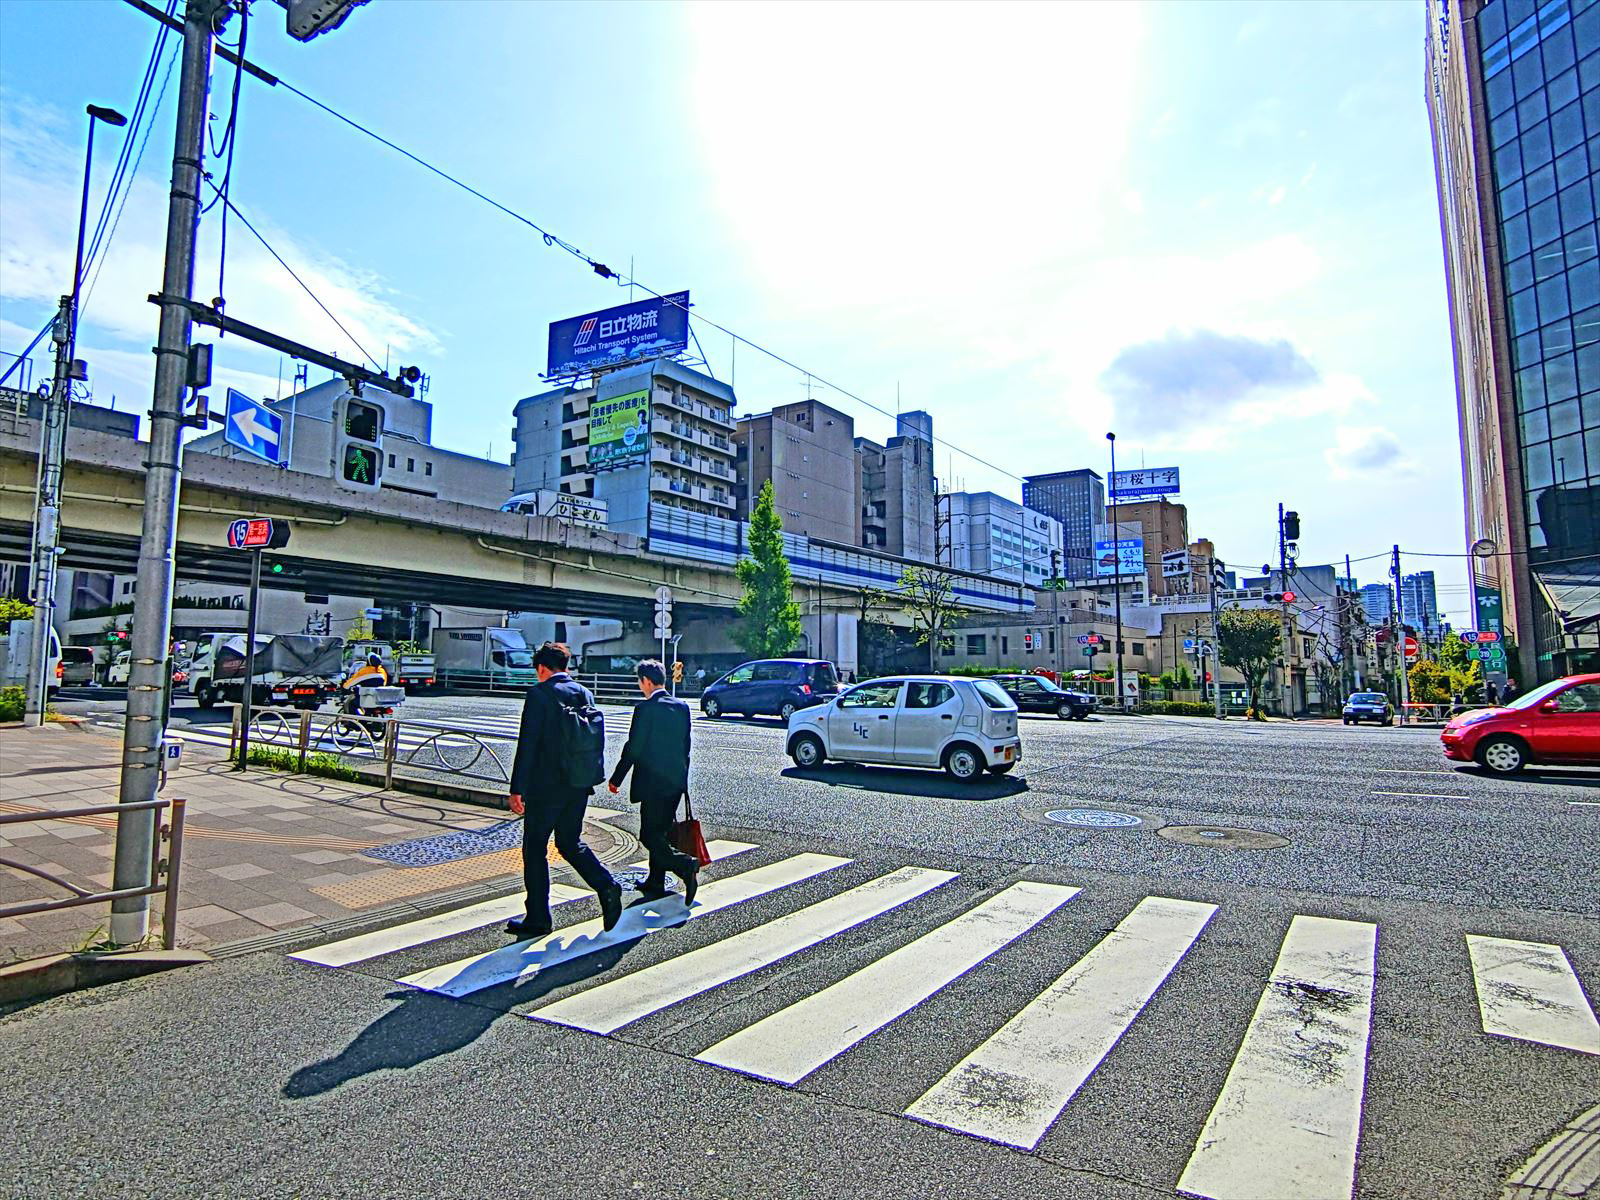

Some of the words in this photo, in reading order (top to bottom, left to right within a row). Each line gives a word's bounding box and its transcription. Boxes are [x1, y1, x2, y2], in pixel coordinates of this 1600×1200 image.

[599, 309, 658, 338] 日立物流
[574, 343, 597, 355] Hitachi
[598, 336, 630, 350] Transport
[631, 332, 658, 345] System
[1130, 470, 1176, 485] 桜十字
[560, 505, 600, 520] ひこぜん
[236, 523, 247, 541] 15
[1467, 633, 1477, 641] 15
[853, 722, 869, 739] LIC
